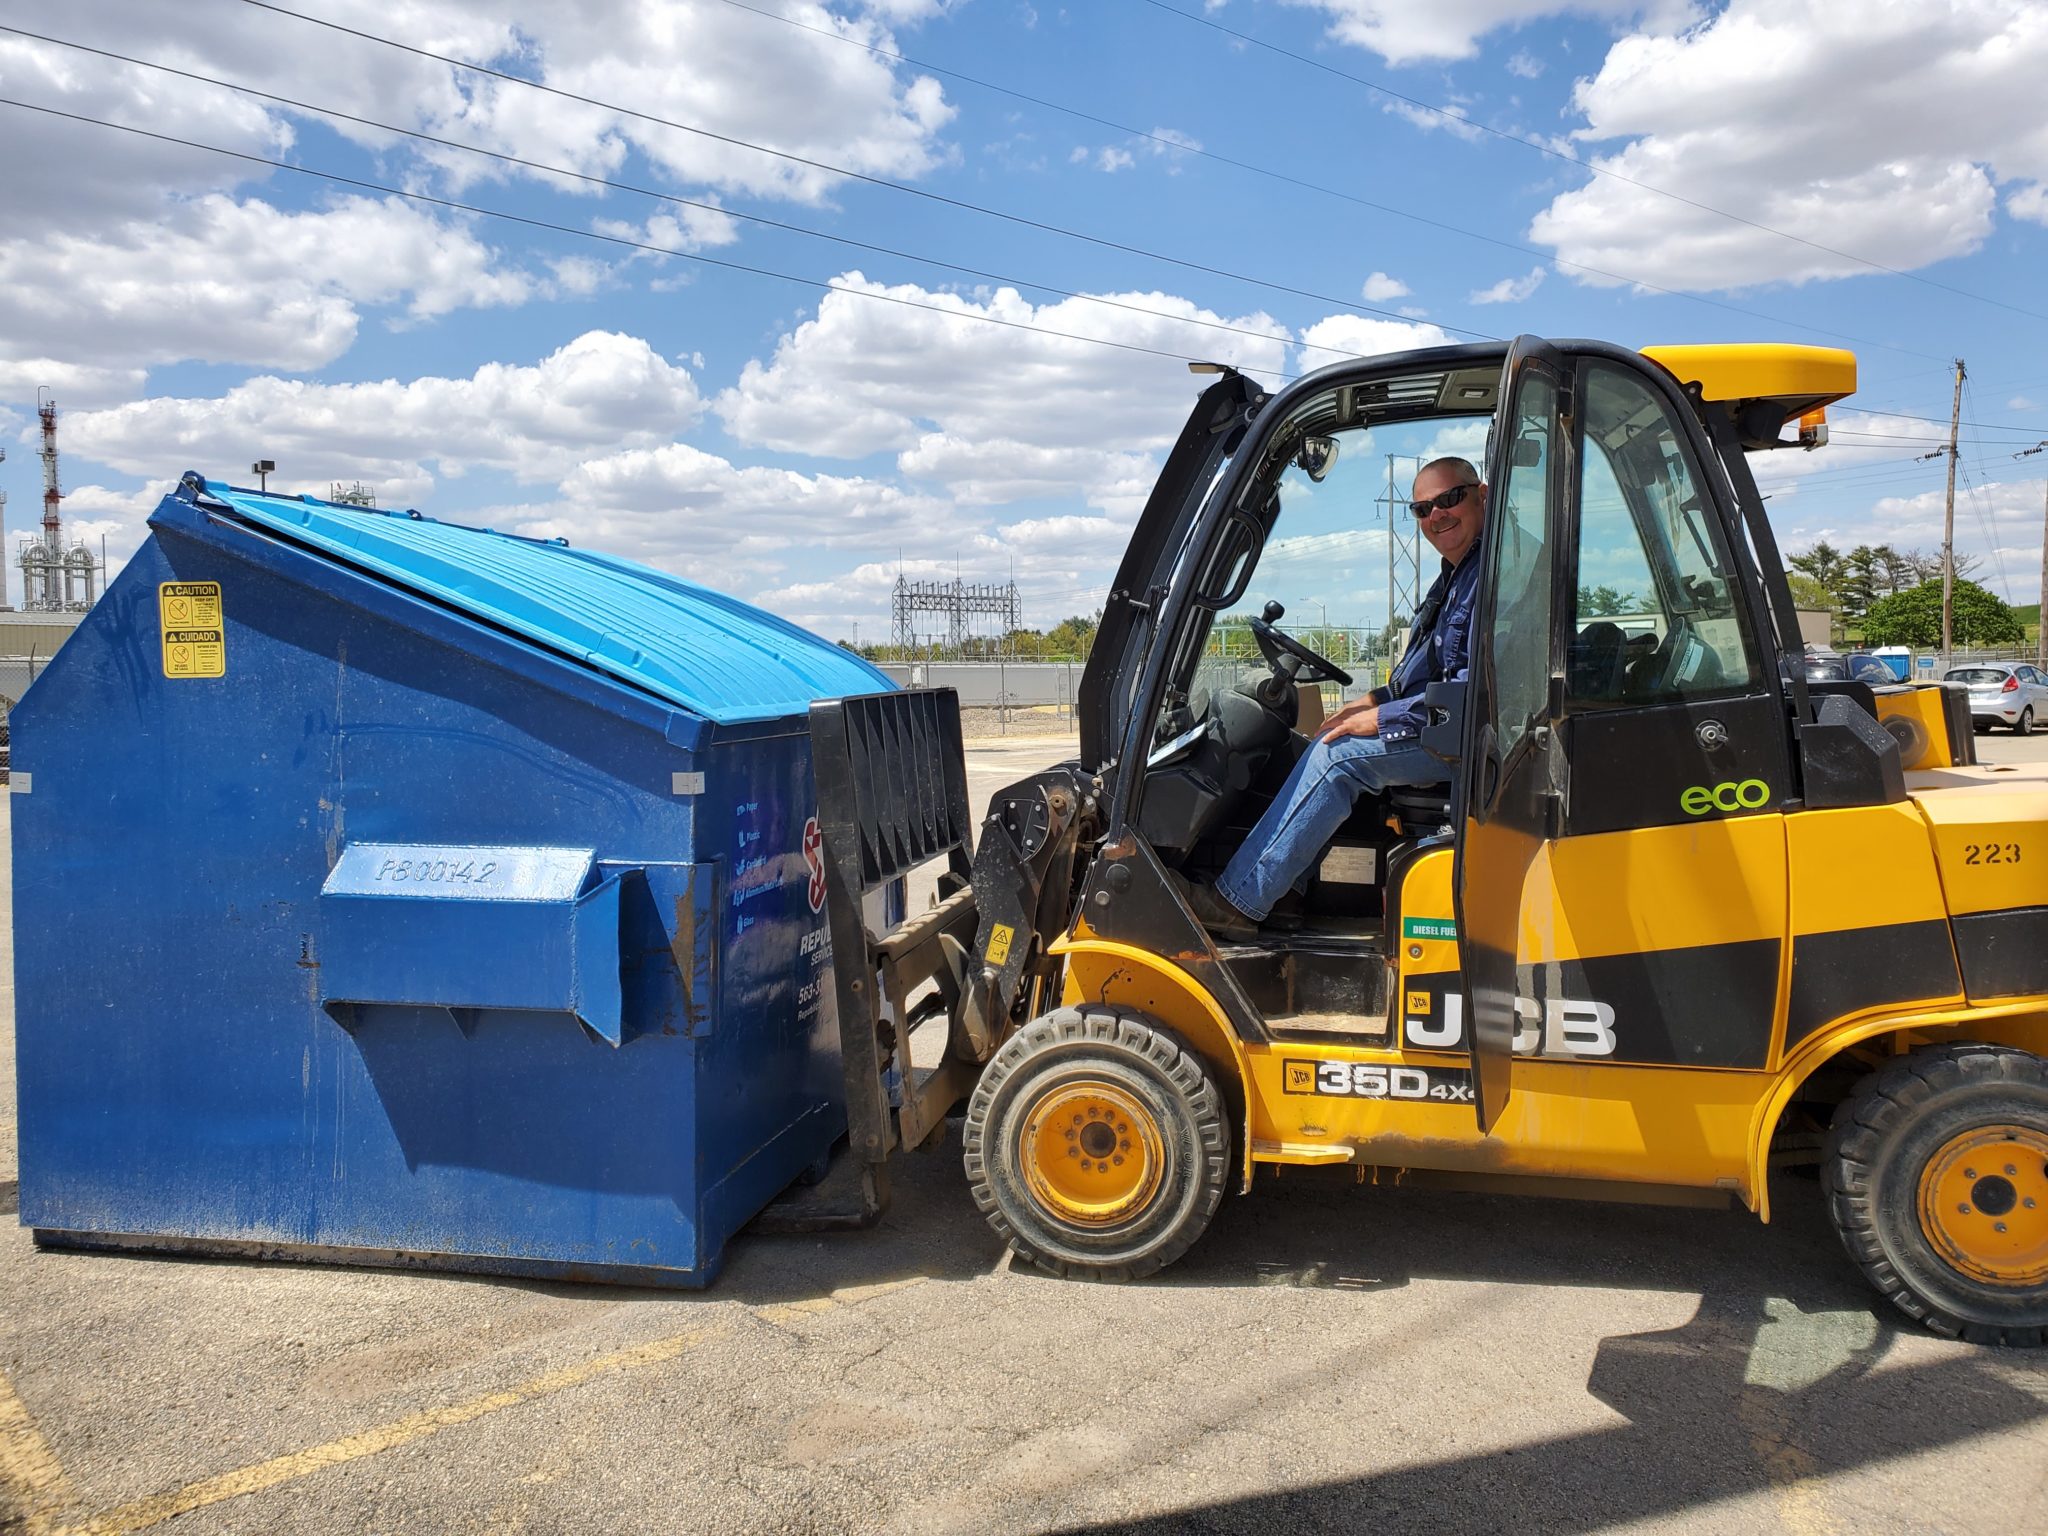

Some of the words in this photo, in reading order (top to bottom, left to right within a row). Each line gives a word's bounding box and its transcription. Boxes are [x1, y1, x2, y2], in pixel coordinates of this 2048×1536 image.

[175, 586, 216, 596] CAUTION
[179, 632, 216, 642] CUIDADO
[1680, 779, 1771, 815] eco
[1965, 843, 2022, 865] 223
[1412, 925, 1439, 936] DIESEL
[1440, 926, 1457, 937] FUE
[1412, 996, 1428, 1009] JCB
[1292, 1069, 1311, 1084] JCB
[1318, 1063, 1429, 1098] 35D
